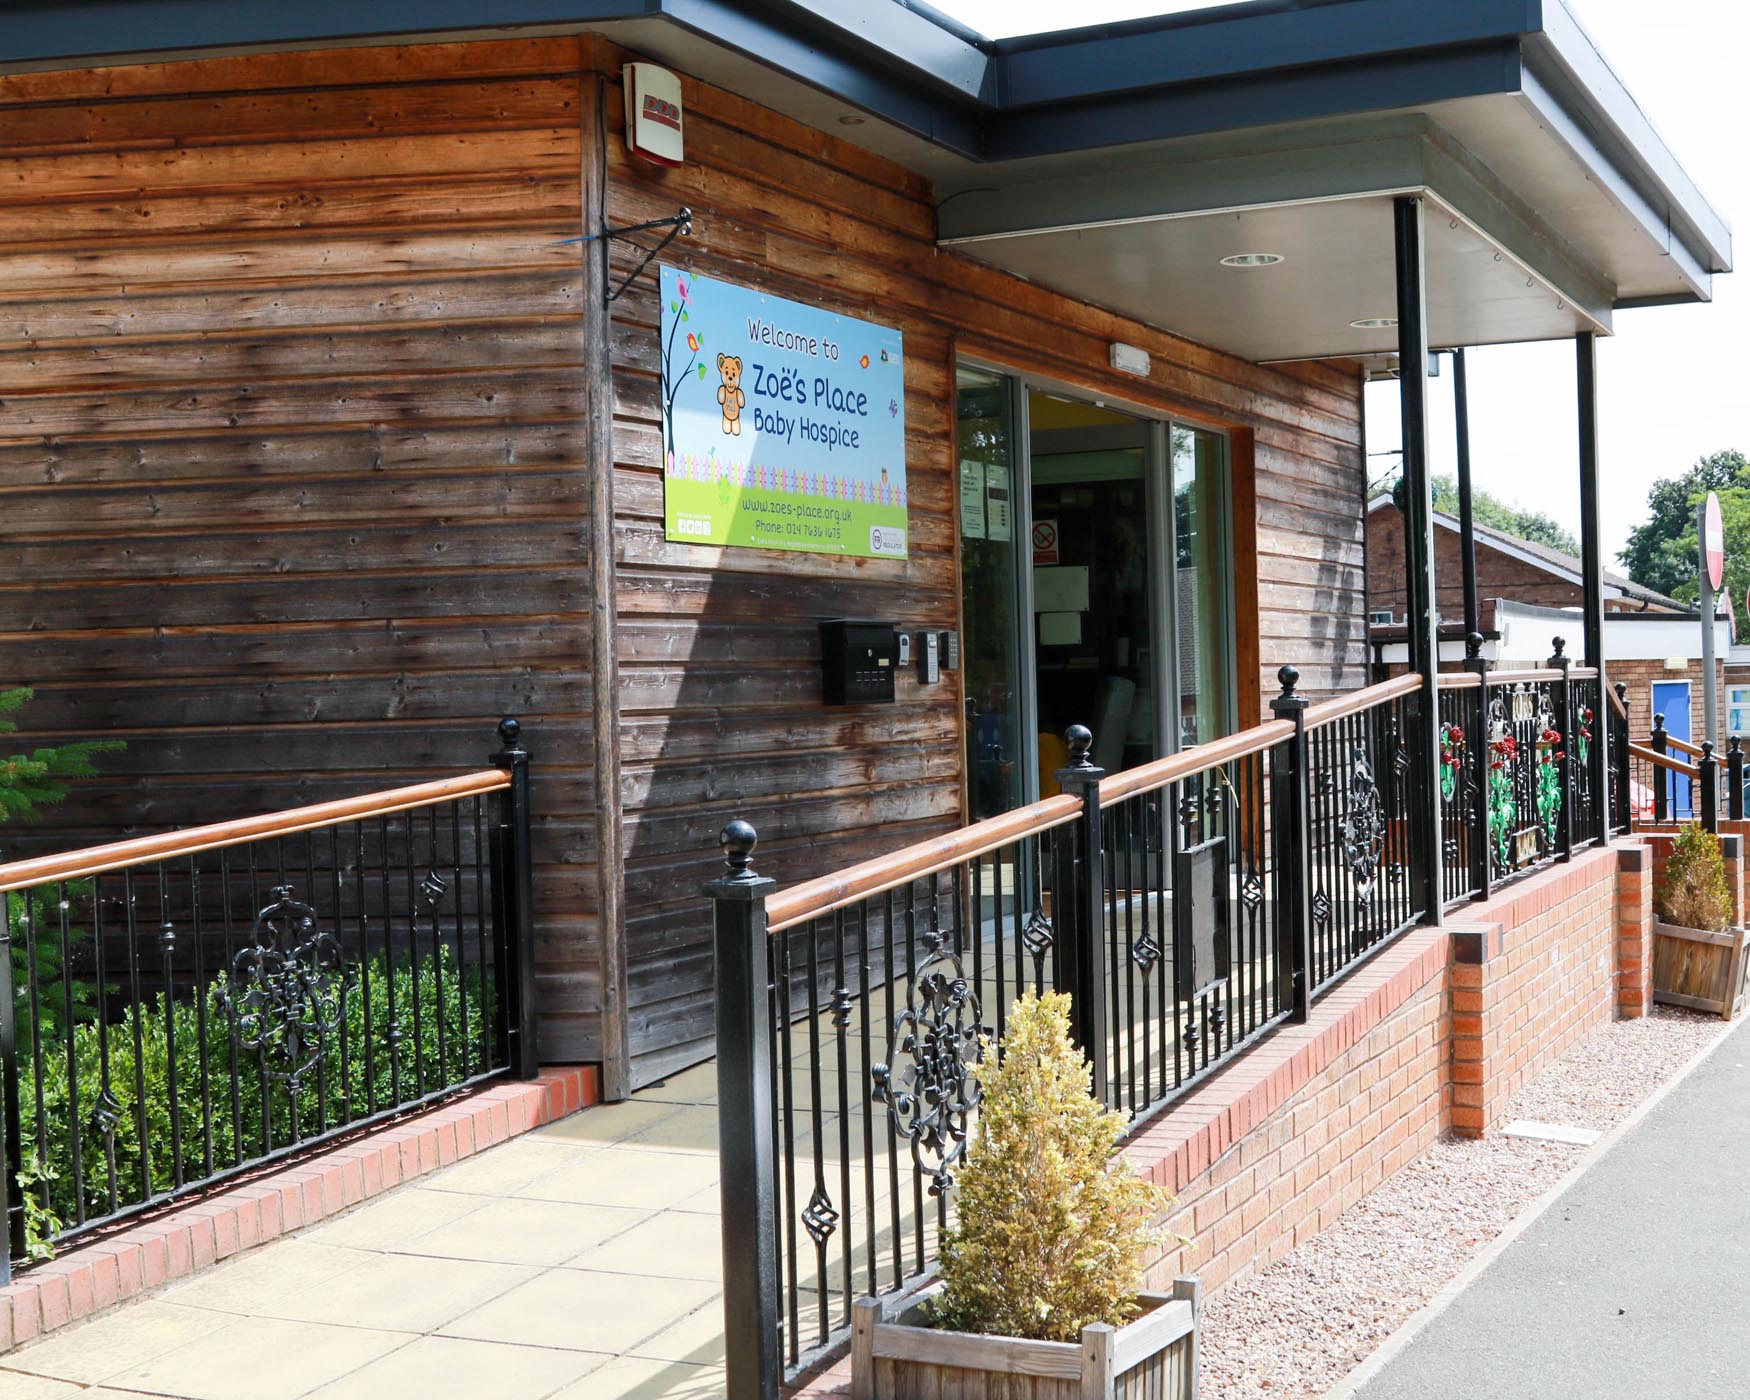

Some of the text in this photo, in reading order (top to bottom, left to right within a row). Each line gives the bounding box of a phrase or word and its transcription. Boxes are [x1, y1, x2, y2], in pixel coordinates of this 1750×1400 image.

[748, 318, 839, 361] Welcome to
[752, 363, 868, 416] Zoë's Place
[754, 407, 860, 451] Baby Hospice
[742, 498, 852, 525] www.zoes-place.org.uk
[755, 519, 841, 539] Phone: 024 7636 1675
